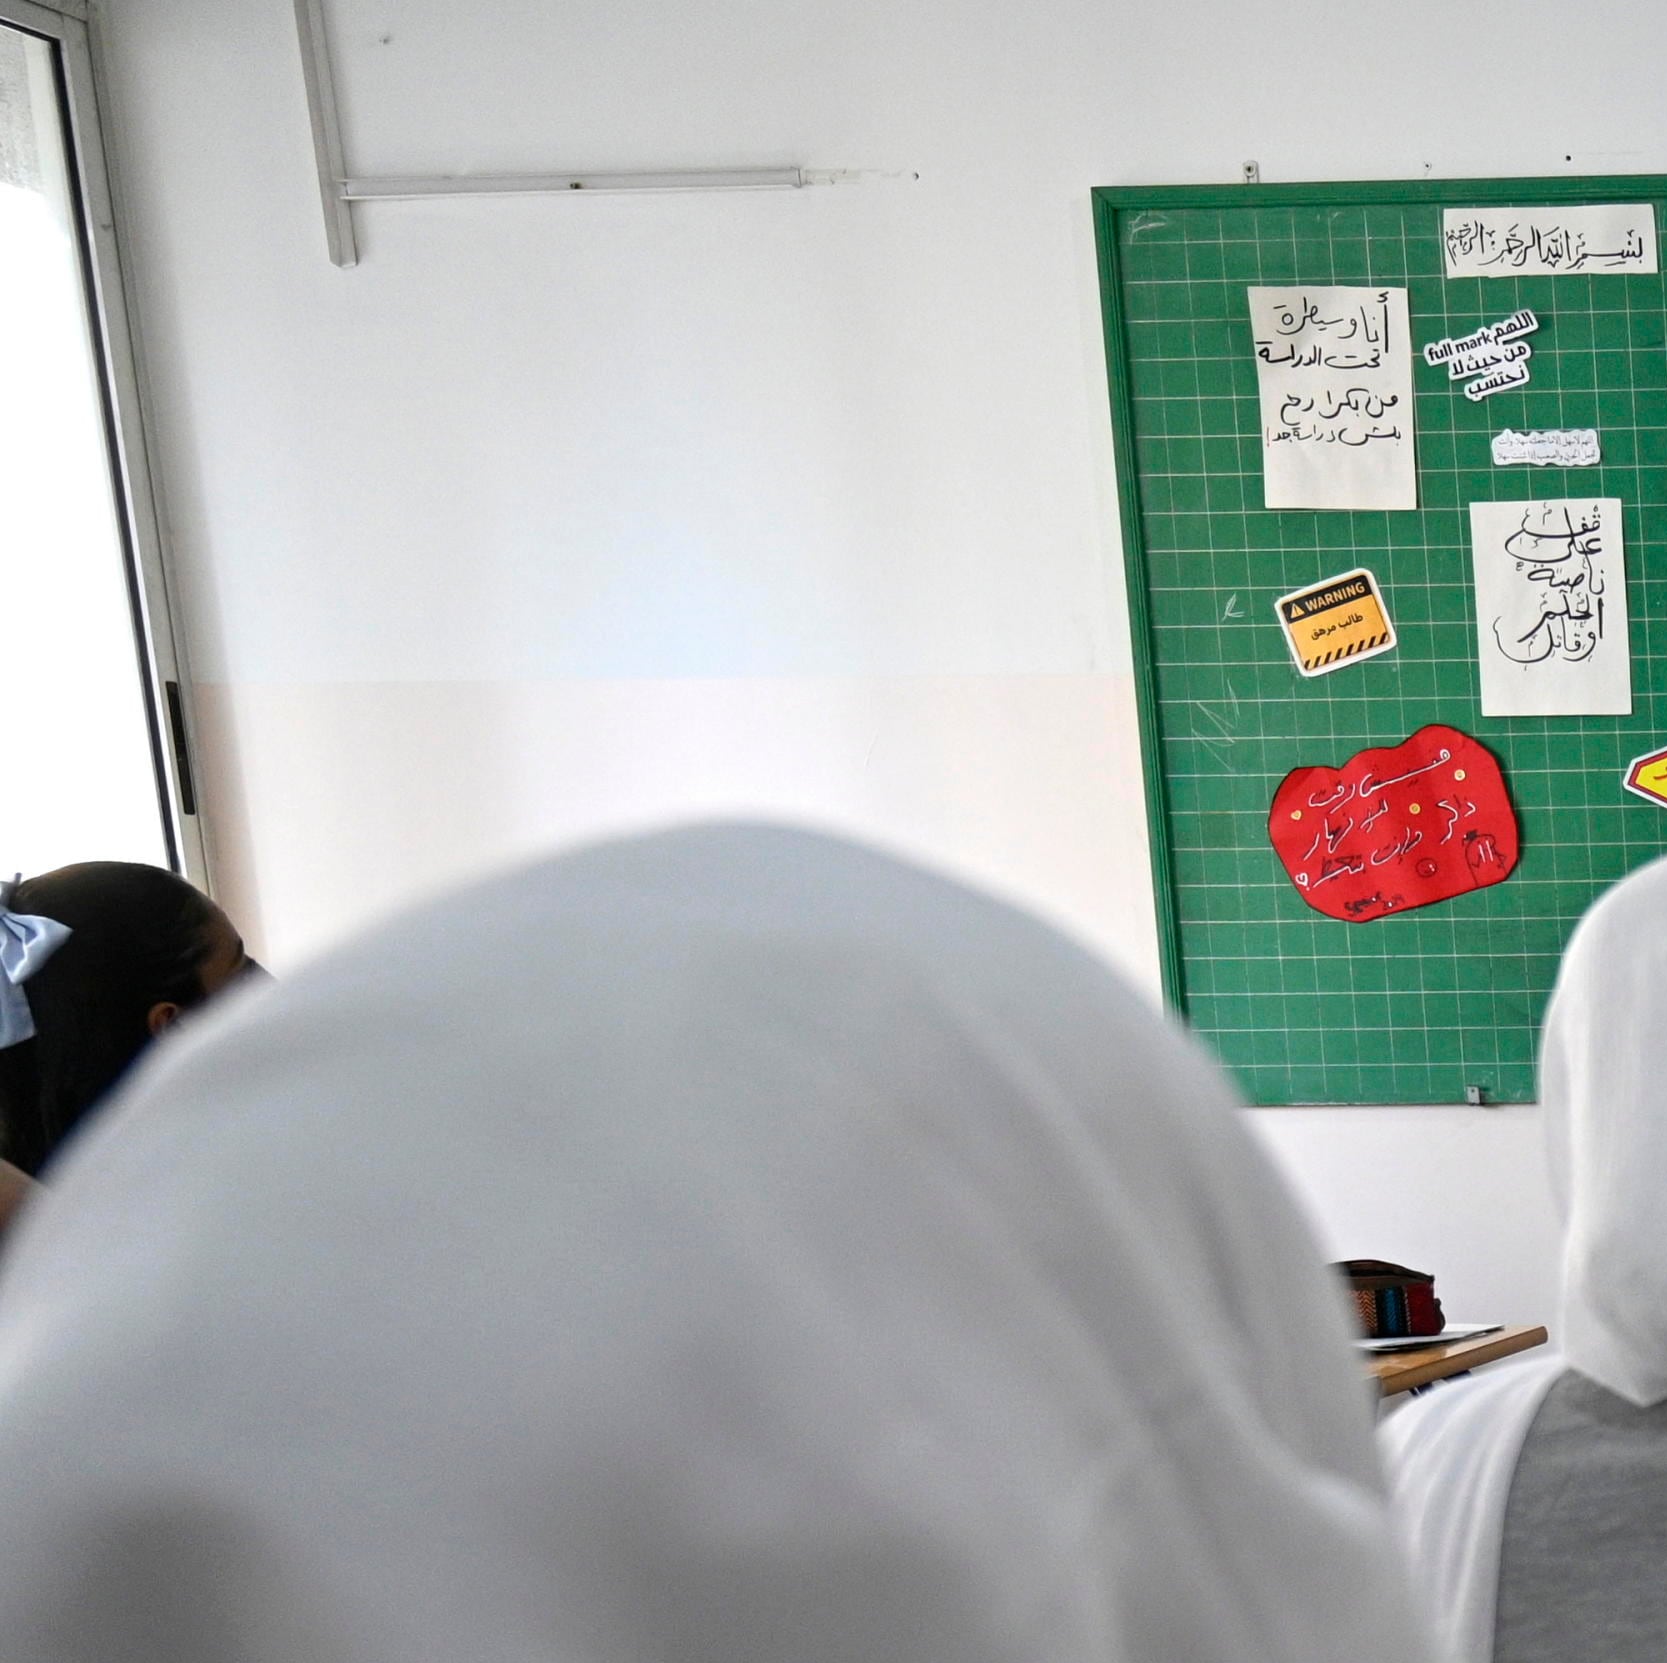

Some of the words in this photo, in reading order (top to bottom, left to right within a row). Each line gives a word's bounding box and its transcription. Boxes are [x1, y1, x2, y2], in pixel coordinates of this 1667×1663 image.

[1493, 311, 1534, 345] اللهم
[1428, 343, 1454, 361] full
[1455, 331, 1493, 354] mark
[1255, 341, 1322, 368] الدراسة
[1324, 348, 1381, 369] تحت
[1467, 354, 1502, 372] حيث
[1504, 345, 1527, 362] من
[1453, 360, 1465, 376] لا
[1468, 364, 1525, 398] نحتسب
[1365, 393, 1399, 418] من
[1305, 582, 1366, 612] WARNING
[1338, 612, 1364, 629] طالب
[1310, 624, 1338, 640] مرهق
